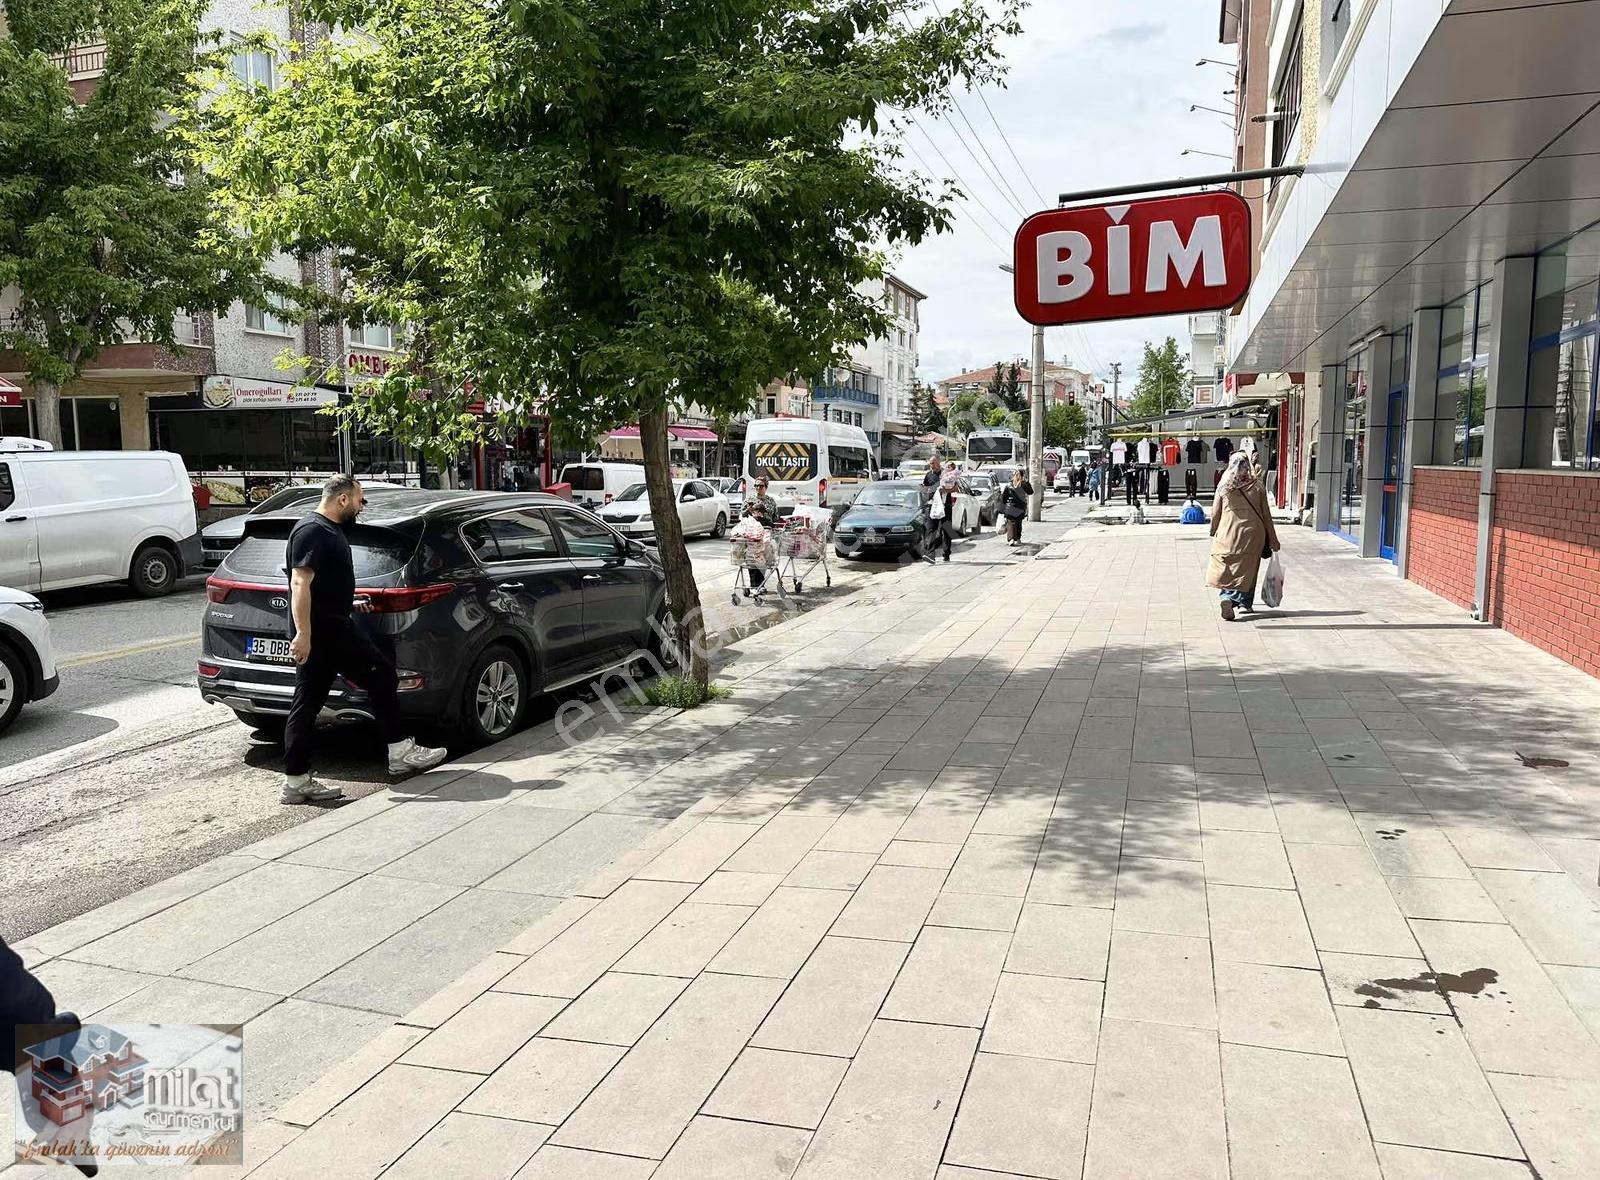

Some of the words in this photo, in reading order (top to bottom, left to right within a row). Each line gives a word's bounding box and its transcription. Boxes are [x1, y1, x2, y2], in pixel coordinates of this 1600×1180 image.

[1036, 204, 1227, 304] BİM
[756, 457, 779, 467] OKUL
[252, 639, 265, 654] 35
